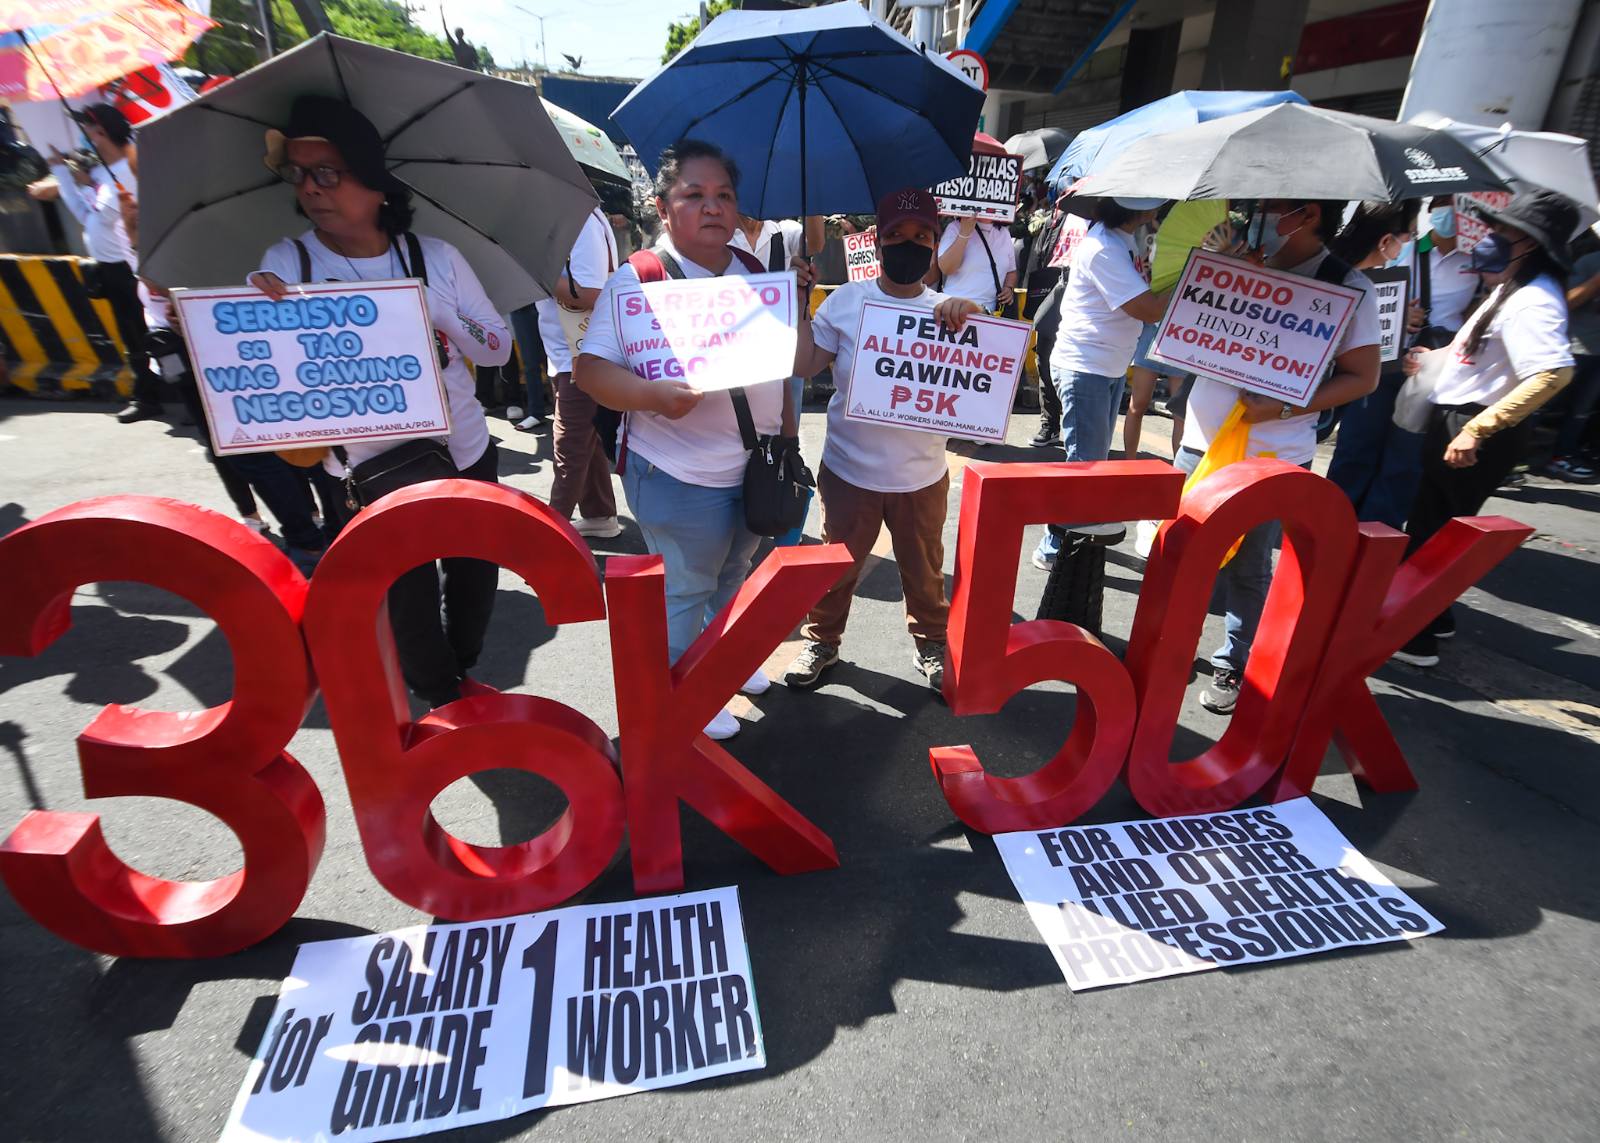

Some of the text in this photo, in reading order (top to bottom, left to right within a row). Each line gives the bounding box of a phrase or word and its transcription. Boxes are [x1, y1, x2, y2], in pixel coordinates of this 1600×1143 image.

[928, 177, 975, 198] RESYO
[976, 156, 1019, 182] ITAAS,
[976, 178, 1018, 202] IBABA!
[1195, 264, 1332, 316] PONDO SA
[213, 294, 378, 335] SERBISYO
[651, 311, 737, 330] SA TAO
[896, 314, 979, 348] PERA
[1182, 285, 1336, 341] KALUSUGAN
[1195, 312, 1280, 349] HINDI SA
[238, 330, 363, 361] sa TAO
[625, 335, 686, 357] HUWAG
[862, 334, 1016, 374] ALLOWANCE
[1165, 323, 1315, 379] KORAPSYON!
[204, 355, 422, 393] WAG GAWING
[875, 357, 992, 394] GAWING
[1196, 359, 1207, 367] ALL
[1219, 366, 1246, 378] WORKERS
[232, 383, 408, 425] NEGOSYO!
[867, 408, 882, 418] ALL
[882, 411, 896, 419] U.P.
[897, 413, 931, 425] WORKERS
[256, 432, 275, 442] ALL
[276, 430, 293, 441] U.P.
[295, 426, 341, 439] WORKERS
[929, 460, 1536, 834] 50K
[0, 478, 855, 958] 36K
[1036, 809, 1294, 868] FOR NURSES
[1067, 841, 1319, 899] AND OTHER
[1056, 865, 1378, 939] ALLIED HEALTH
[1055, 895, 1431, 983] PROFESSIONALS
[351, 900, 729, 1100] SALARY 1 HEALTH
[251, 973, 758, 1136] for GRADE WORKER
